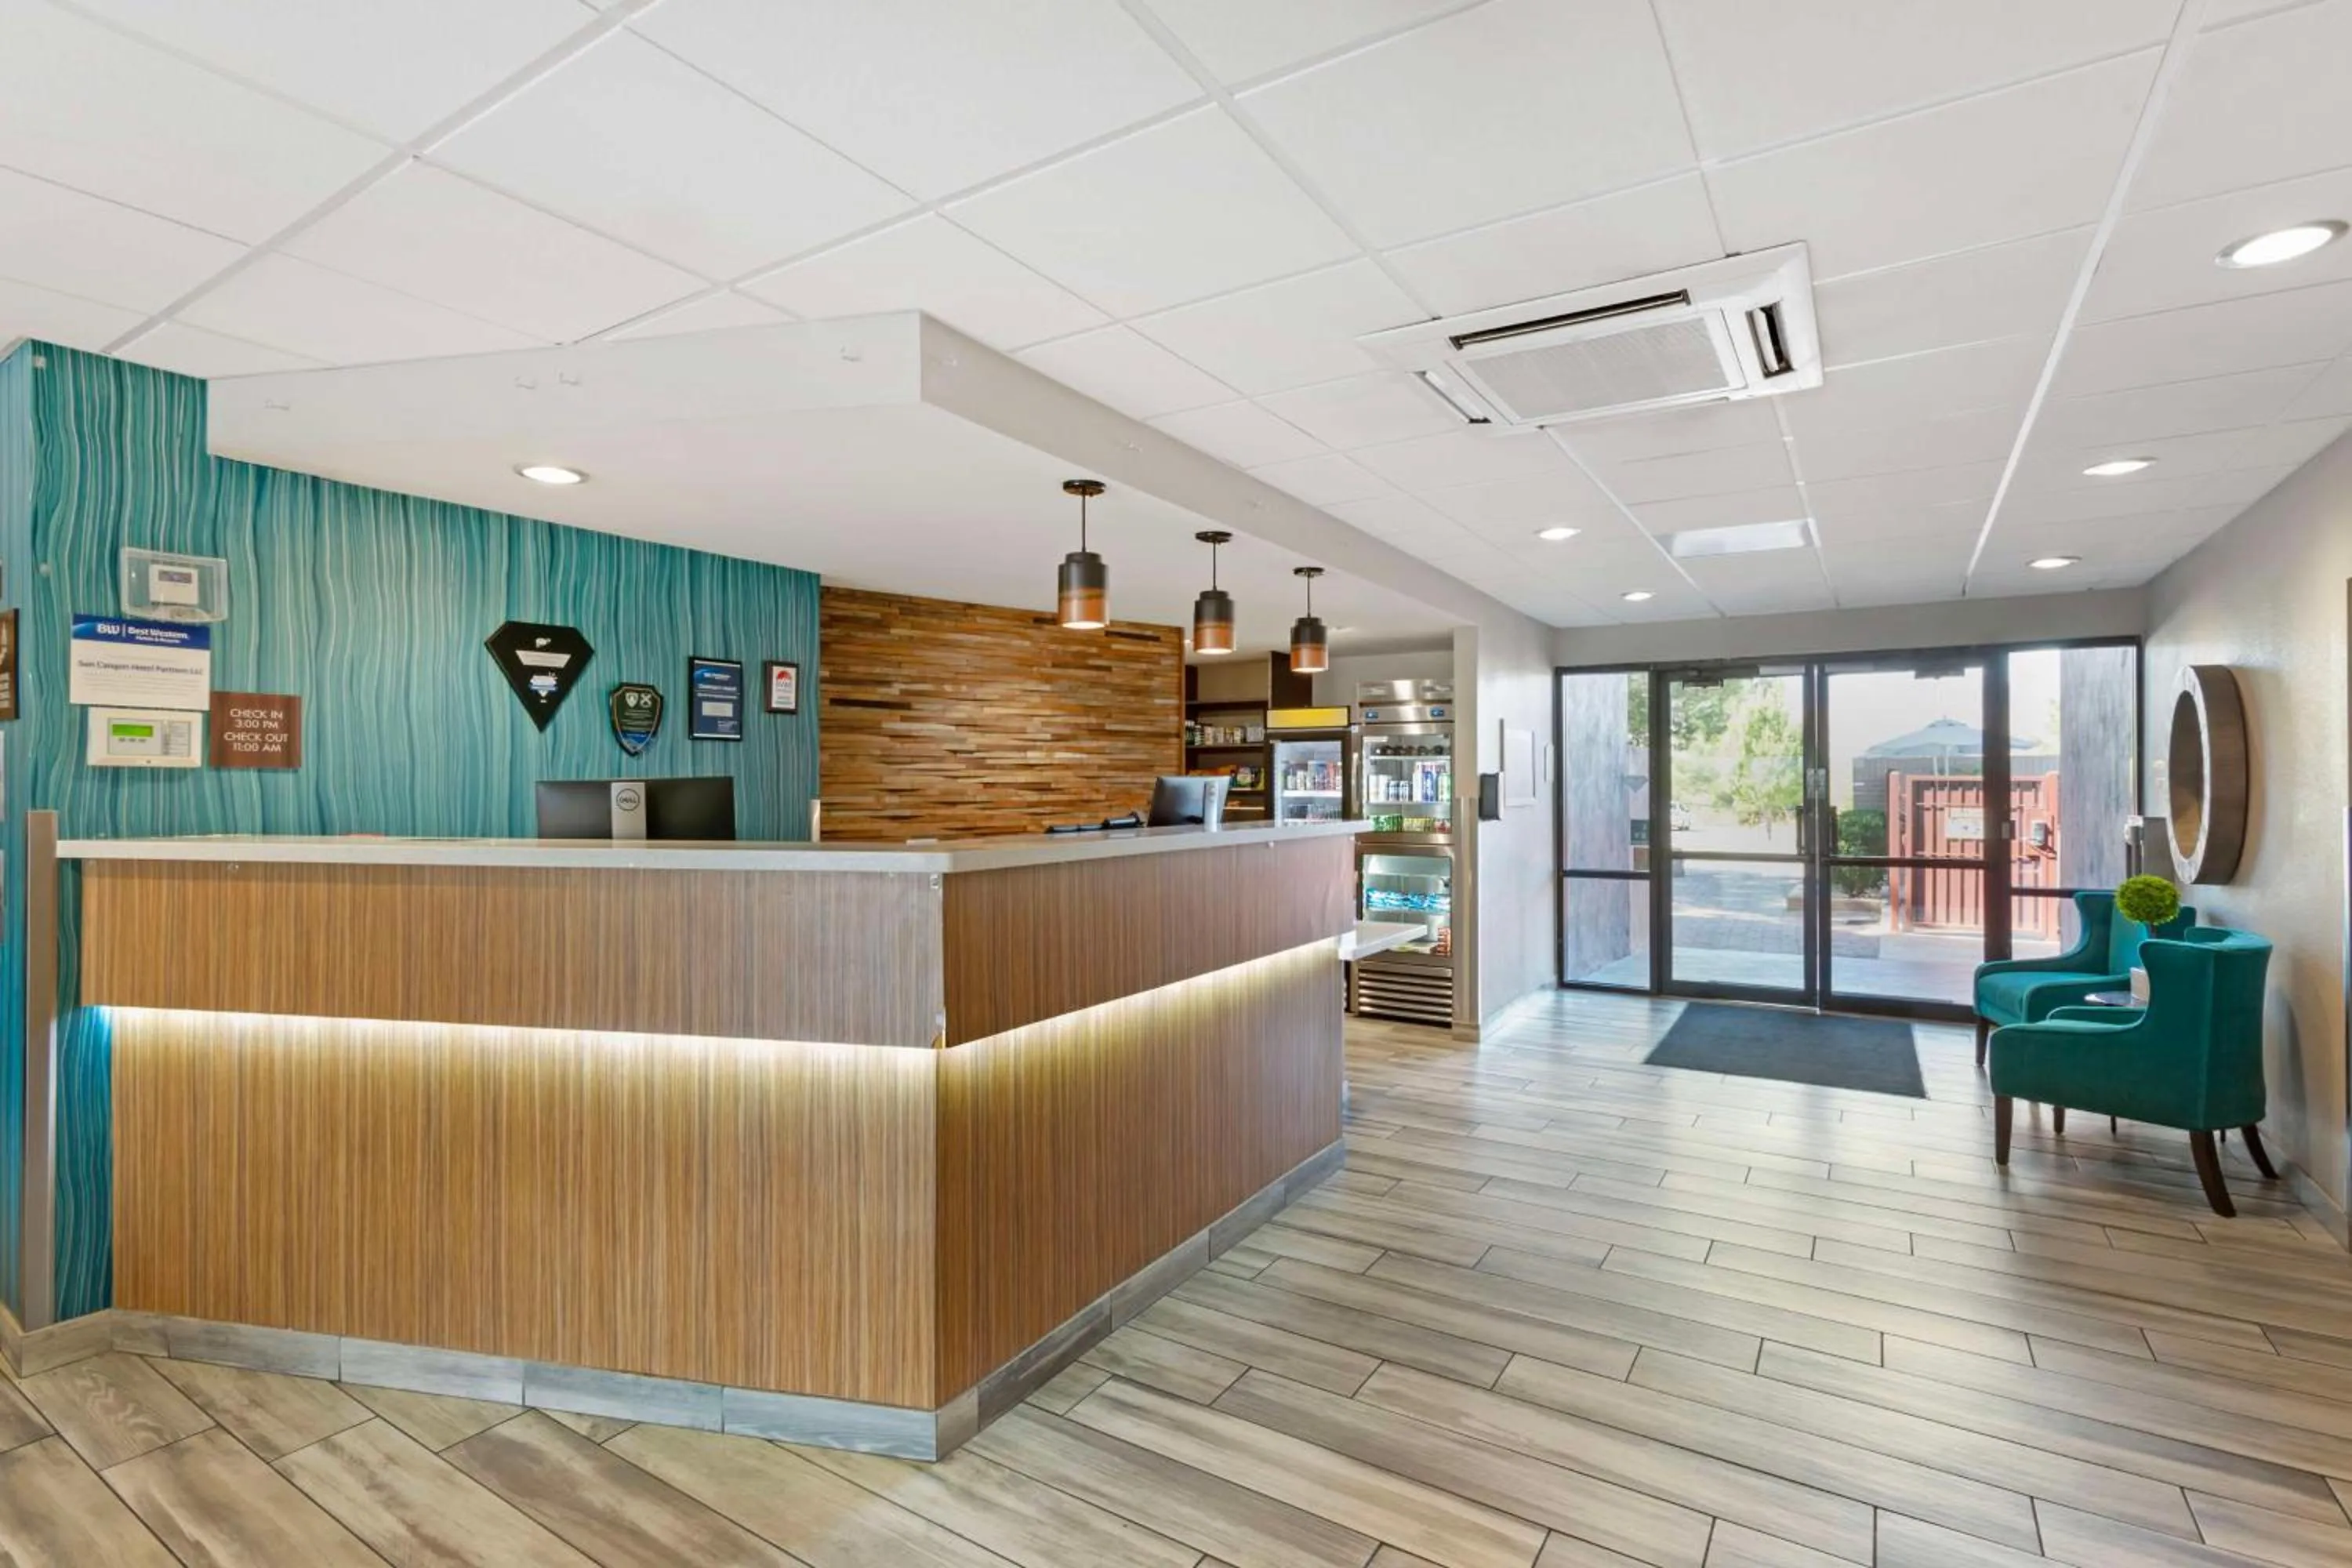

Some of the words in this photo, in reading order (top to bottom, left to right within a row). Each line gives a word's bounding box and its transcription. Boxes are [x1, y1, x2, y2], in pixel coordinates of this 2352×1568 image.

[128, 626, 148, 636] Best
[150, 629, 188, 639] Western
[230, 709, 267, 718] CHECK
[270, 710, 283, 720] IN
[235, 720, 260, 728] 3:00
[263, 720, 279, 729] PM
[224, 731, 261, 742] CHECK
[265, 733, 289, 742] OUT
[262, 744, 281, 753] AM
